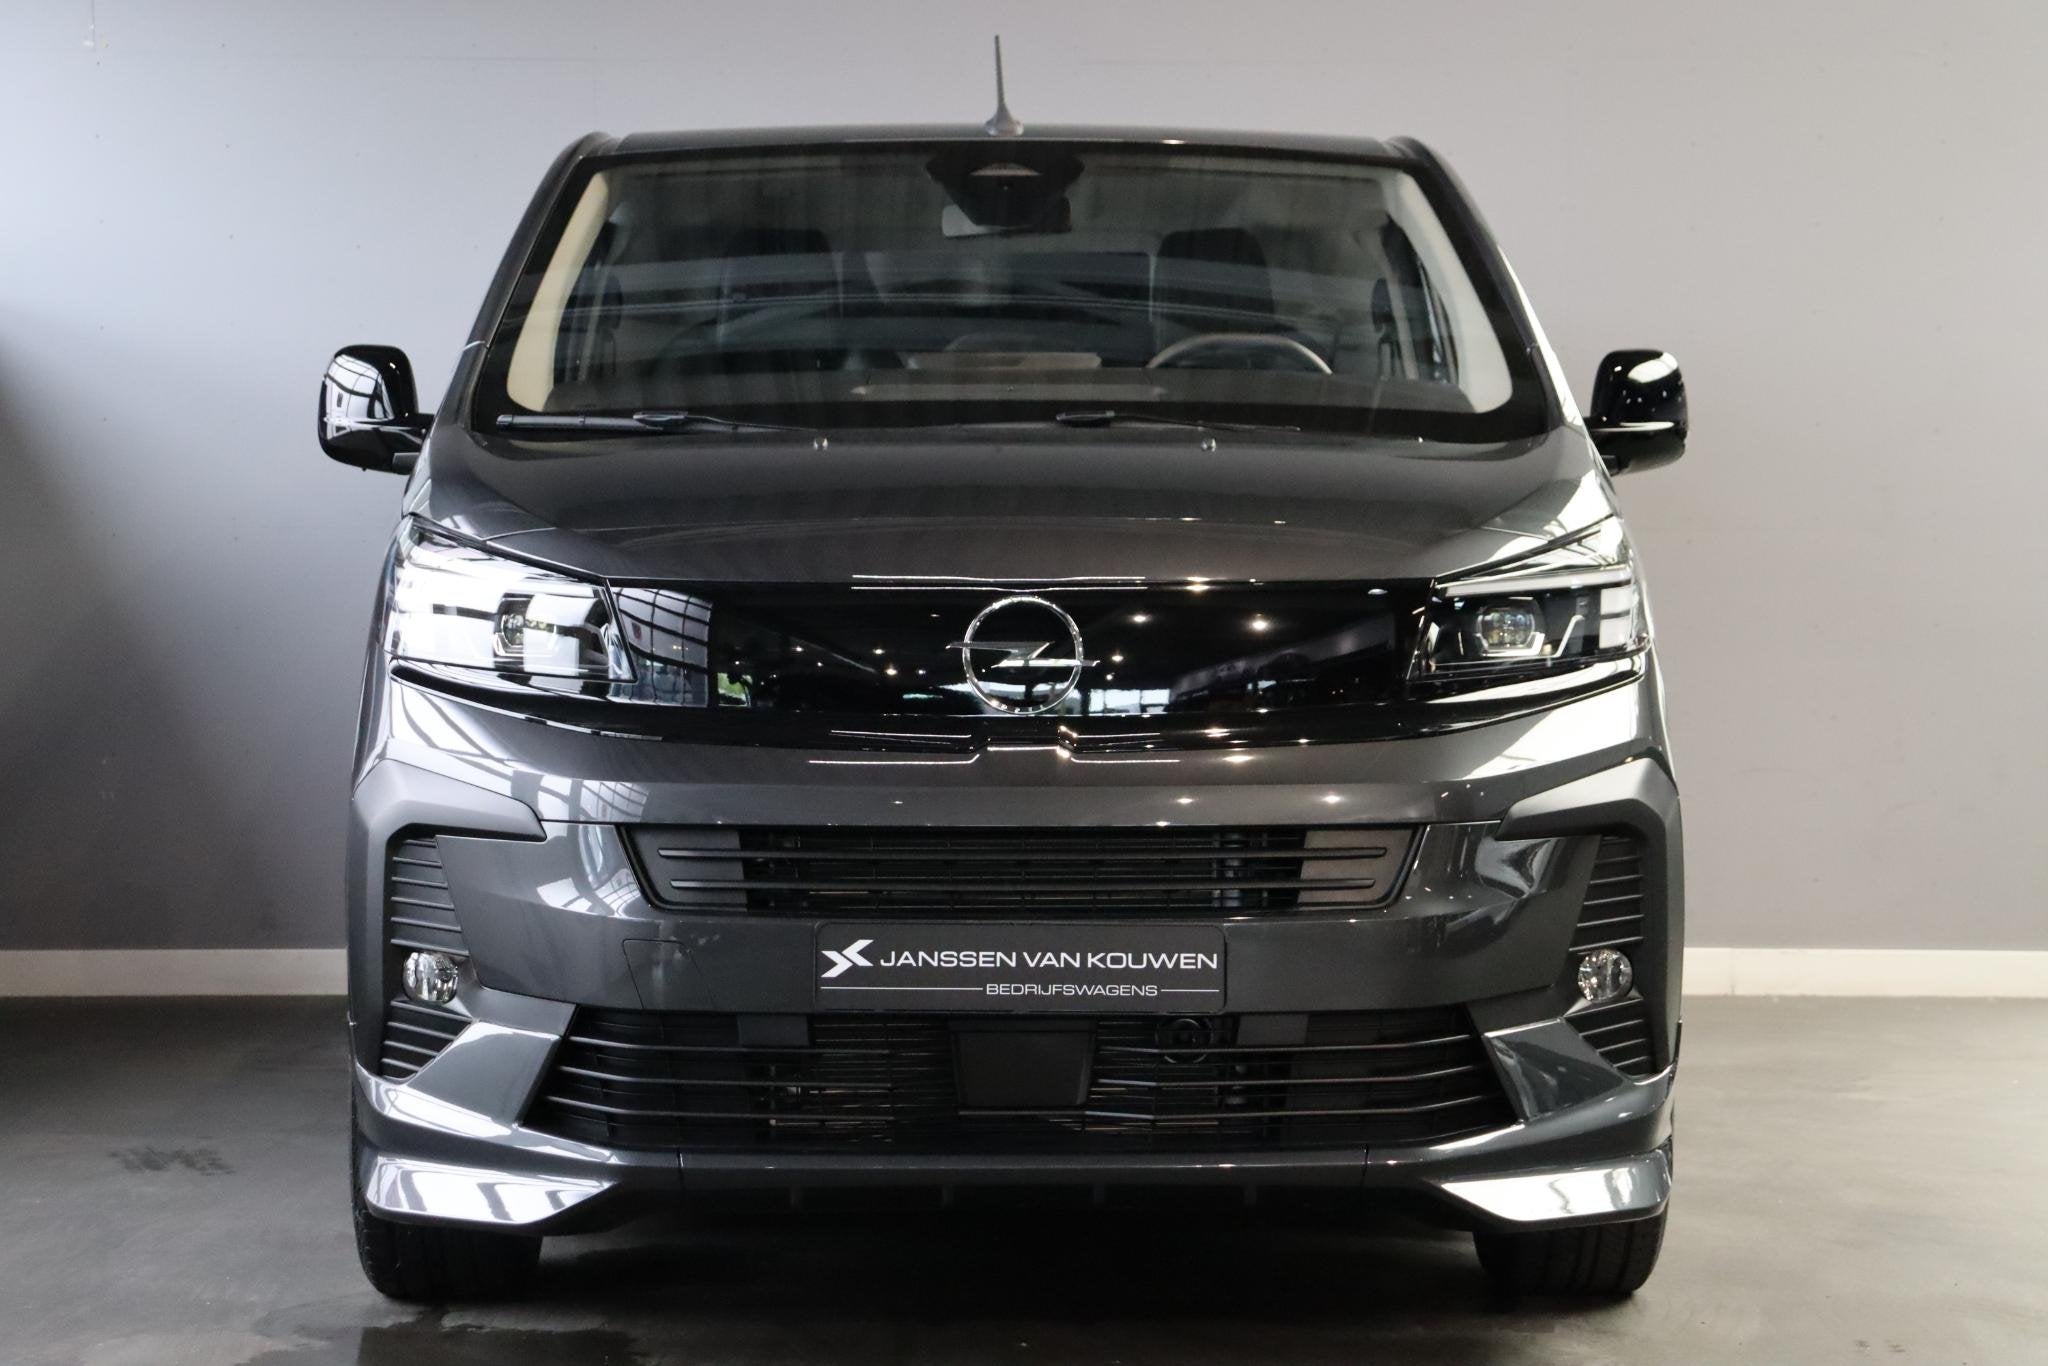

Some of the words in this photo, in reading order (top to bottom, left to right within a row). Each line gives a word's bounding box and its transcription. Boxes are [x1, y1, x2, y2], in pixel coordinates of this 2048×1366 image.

[879, 950, 1016, 967] JANSSEN
[1023, 951, 1080, 968] VAN
[1087, 952, 1218, 970] KOUWEN
[986, 983, 1158, 996] BEDRIJFSWAGENS
